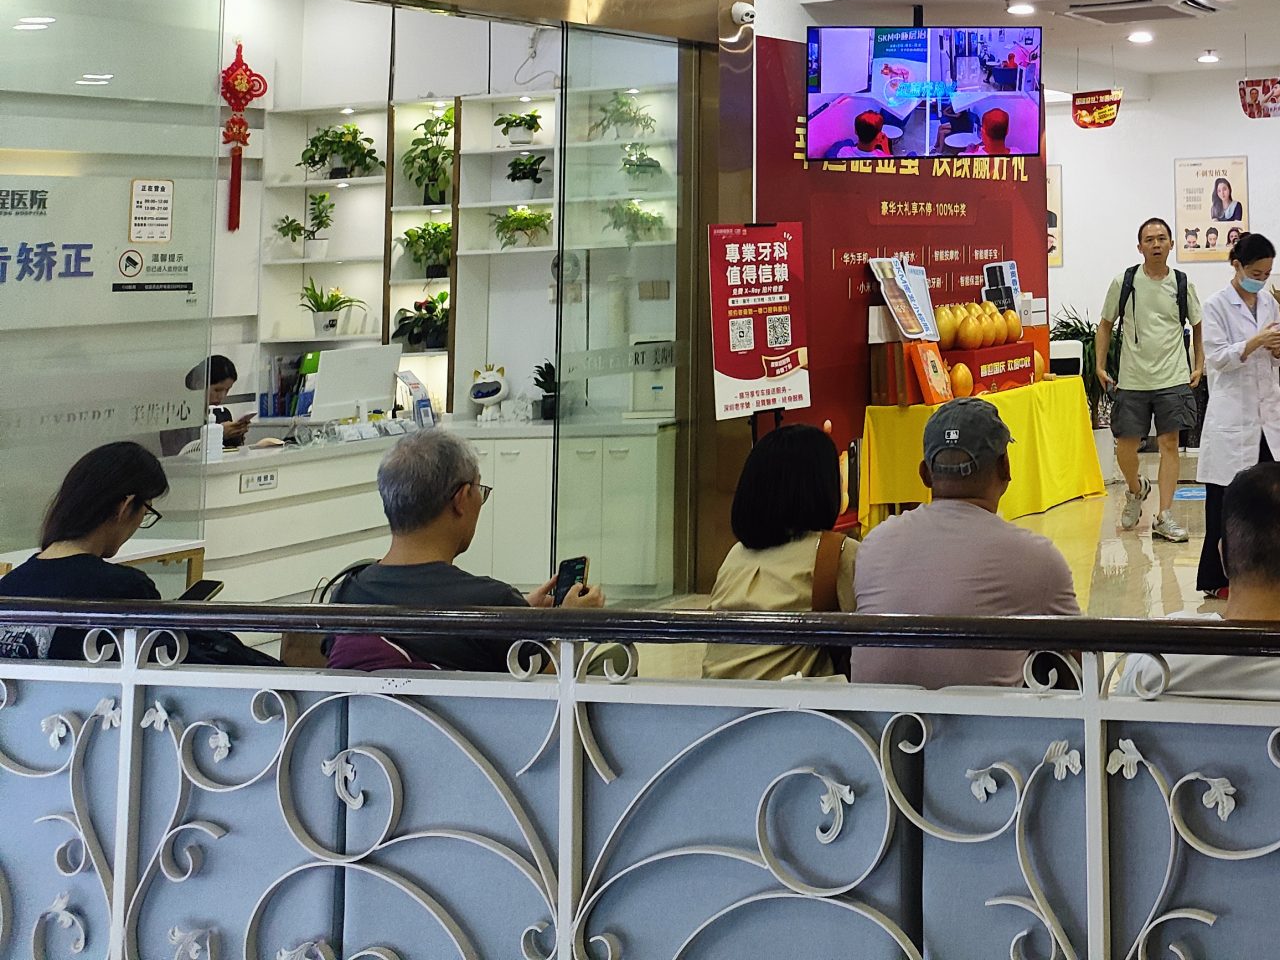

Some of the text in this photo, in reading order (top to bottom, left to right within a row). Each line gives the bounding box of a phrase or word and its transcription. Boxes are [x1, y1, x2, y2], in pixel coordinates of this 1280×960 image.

[881, 200, 967, 217] 豪华大礼享不停·100%中奖
[152, 253, 184, 263] 温馨提示
[725, 241, 788, 263] 專業牙科
[726, 262, 789, 286] 值得信賴
